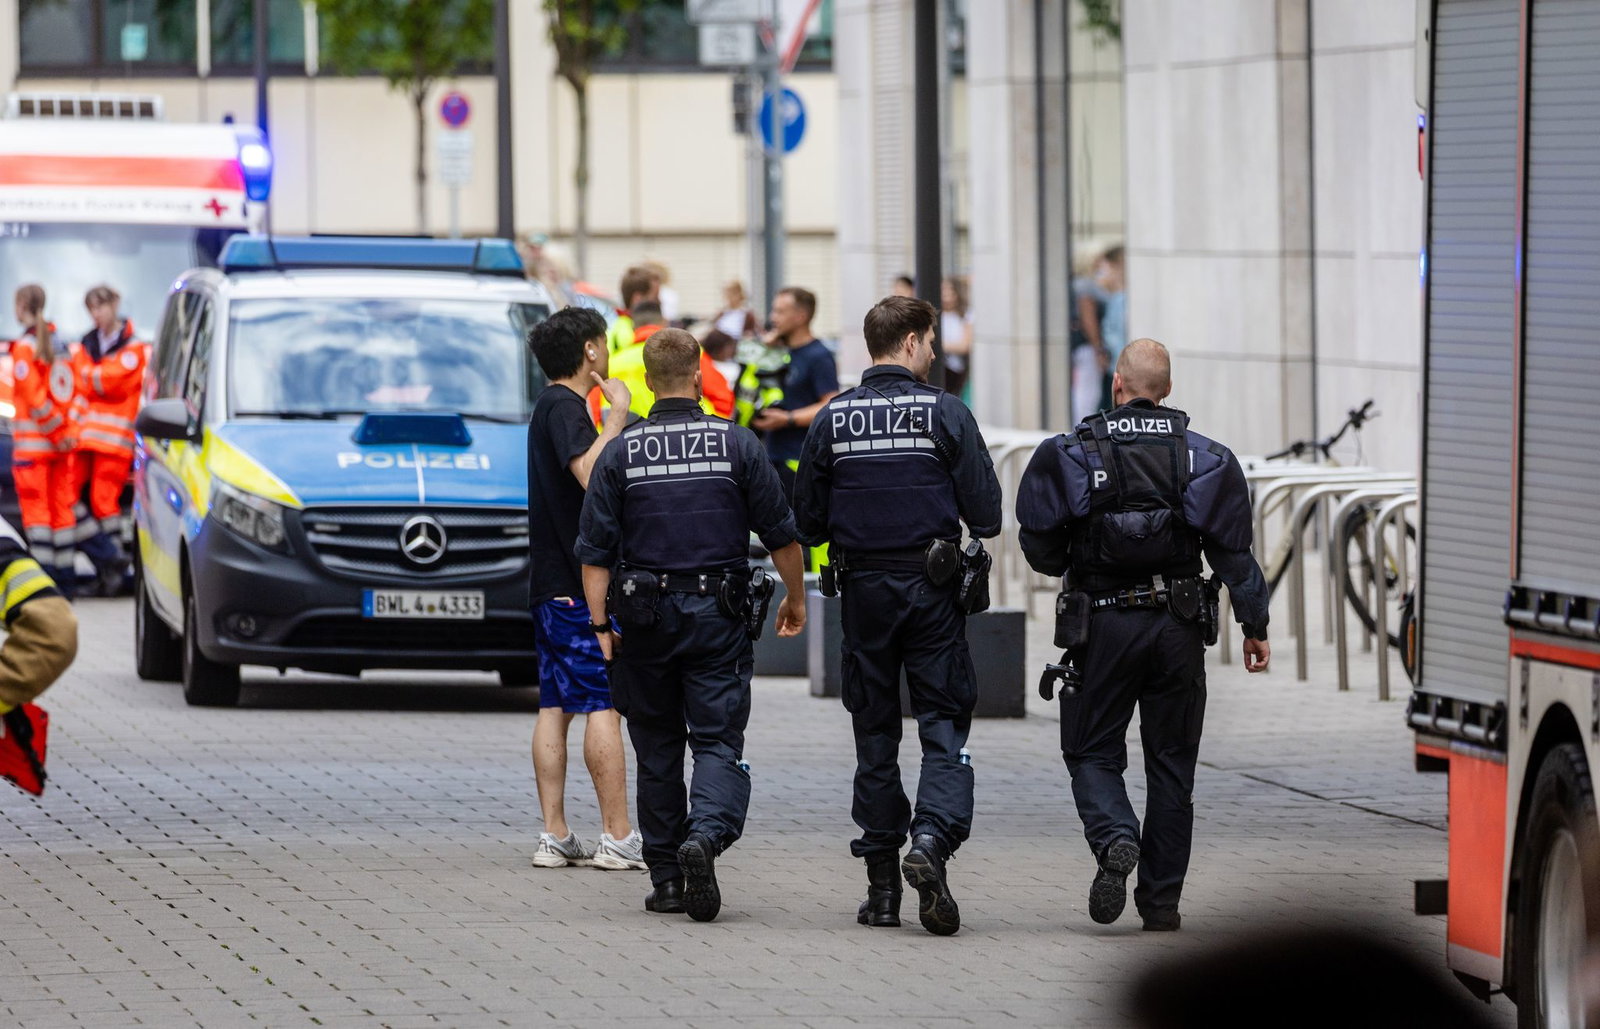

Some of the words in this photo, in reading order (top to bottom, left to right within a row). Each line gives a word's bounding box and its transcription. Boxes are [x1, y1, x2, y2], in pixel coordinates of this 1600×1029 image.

[832, 407, 932, 438] POLIZEI
[1107, 417, 1173, 434] POLIZEI
[627, 432, 727, 463] POLIZEI
[337, 452, 491, 469] POLIZEI
